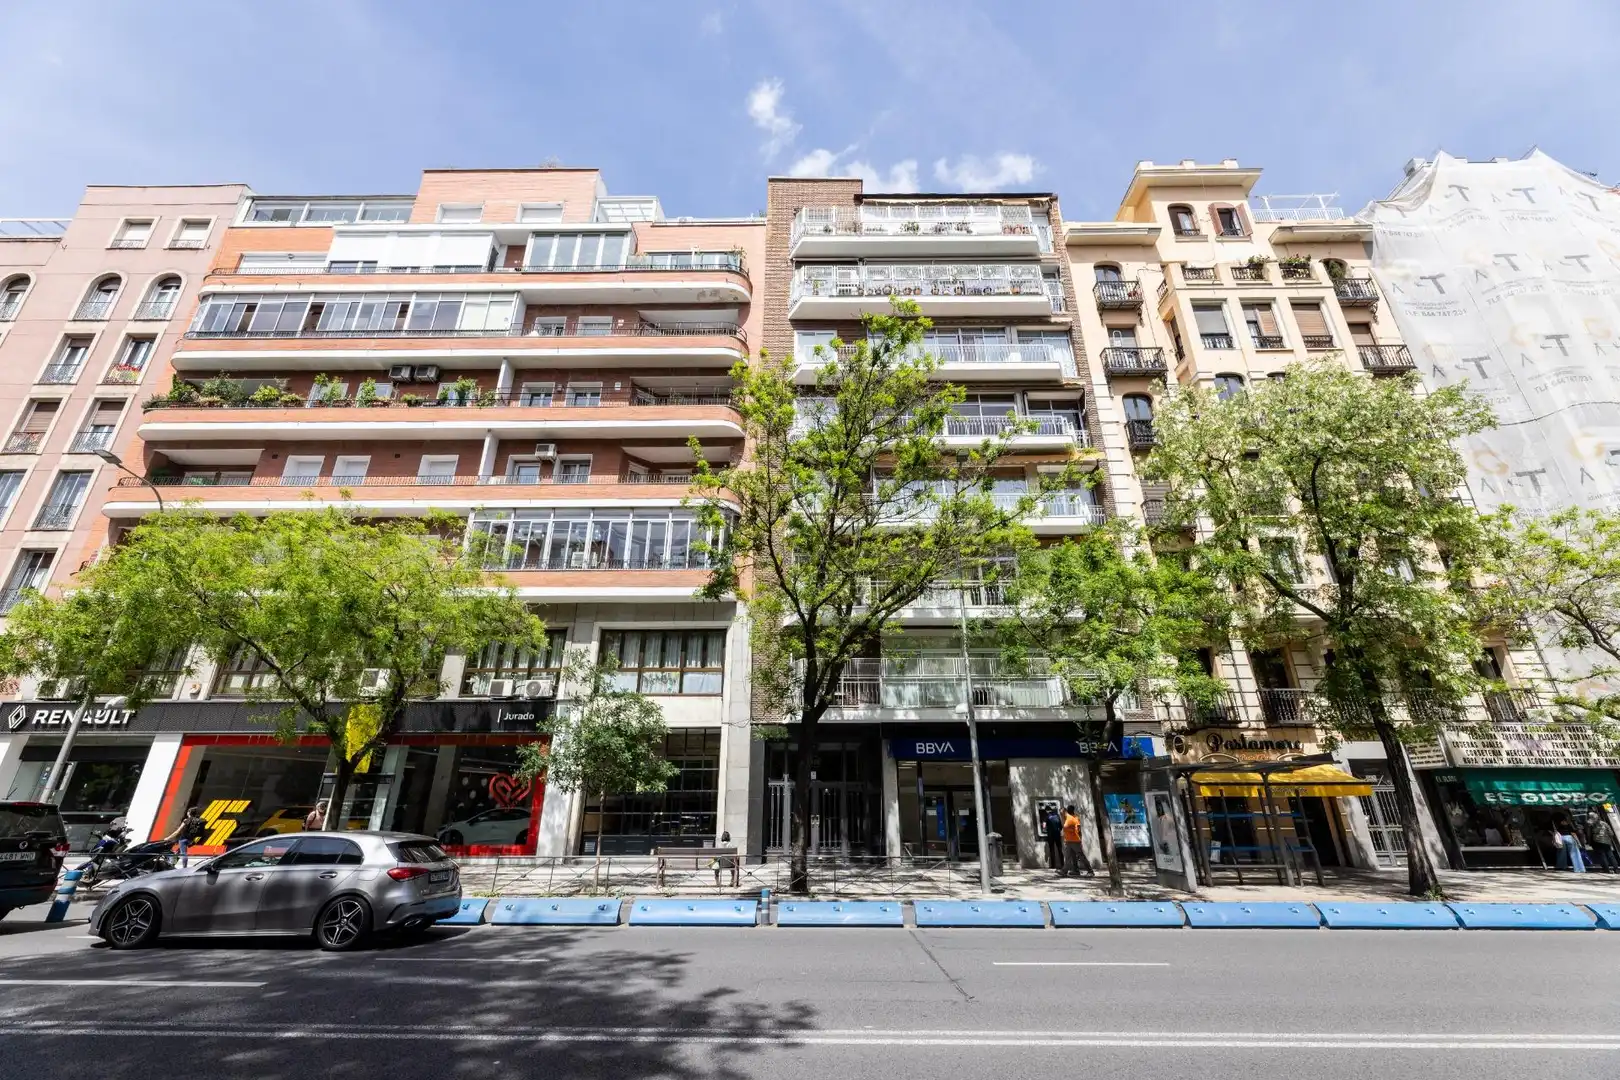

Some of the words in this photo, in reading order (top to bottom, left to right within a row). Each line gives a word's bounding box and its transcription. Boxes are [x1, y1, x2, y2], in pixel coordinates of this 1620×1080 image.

[31, 709, 136, 725] RENAULT
[503, 711, 535, 721] Jurado
[1537, 733, 1565, 741] PLISADOS
[915, 742, 955, 754] BBVA
[1079, 742, 1119, 754] BBA
[1507, 757, 1524, 765] MESA
[1527, 757, 1561, 765] ACORTAMOS
[1520, 792, 1611, 803] GLOBO
